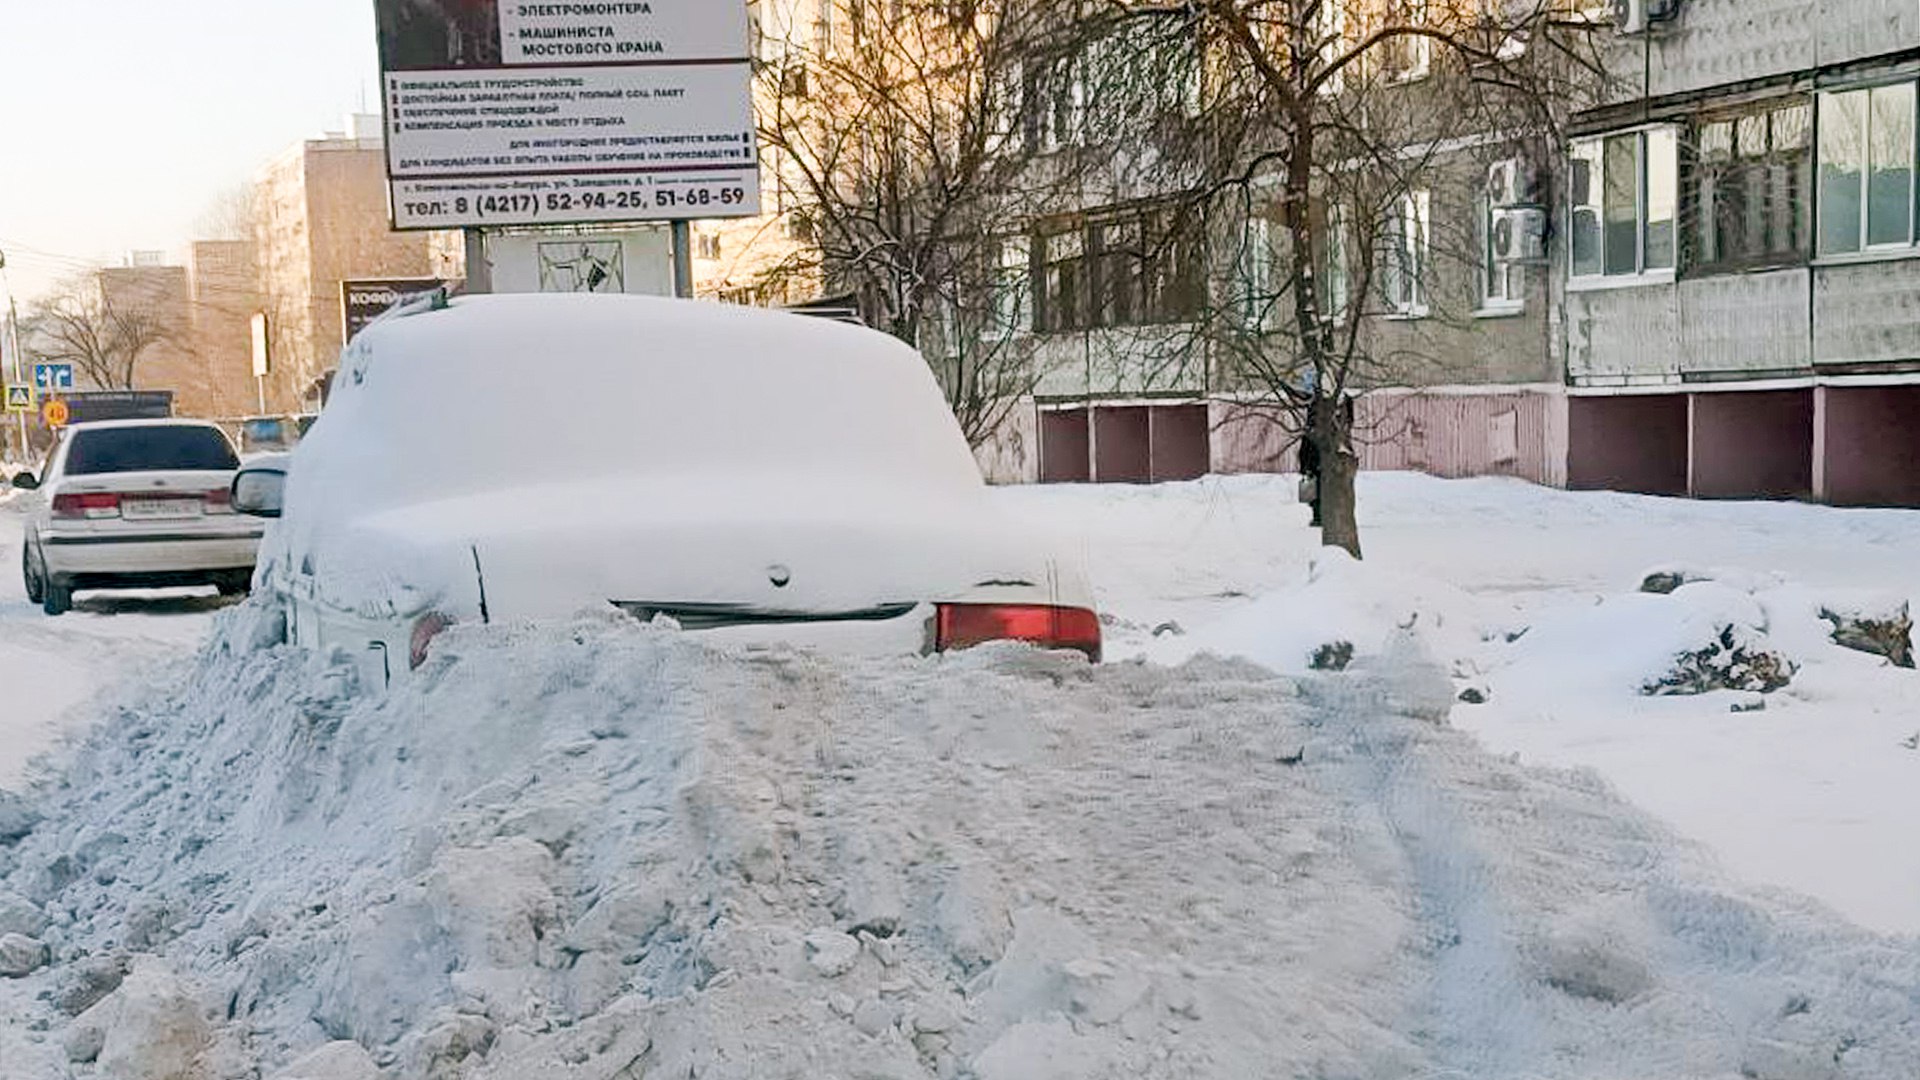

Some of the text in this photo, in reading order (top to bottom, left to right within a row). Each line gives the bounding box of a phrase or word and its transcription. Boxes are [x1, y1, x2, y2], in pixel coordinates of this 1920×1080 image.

[518, 3, 651, 16] ЭЛЕКТРОМОНТЕРА
[519, 27, 614, 38] МАШИНИСТА
[522, 41, 663, 55] МОСТОВОГО КРАНА
[653, 88, 685, 98] ПАКЕТ
[405, 188, 743, 216] тел: 8 (4217) 52-94-25, 51-68-59
